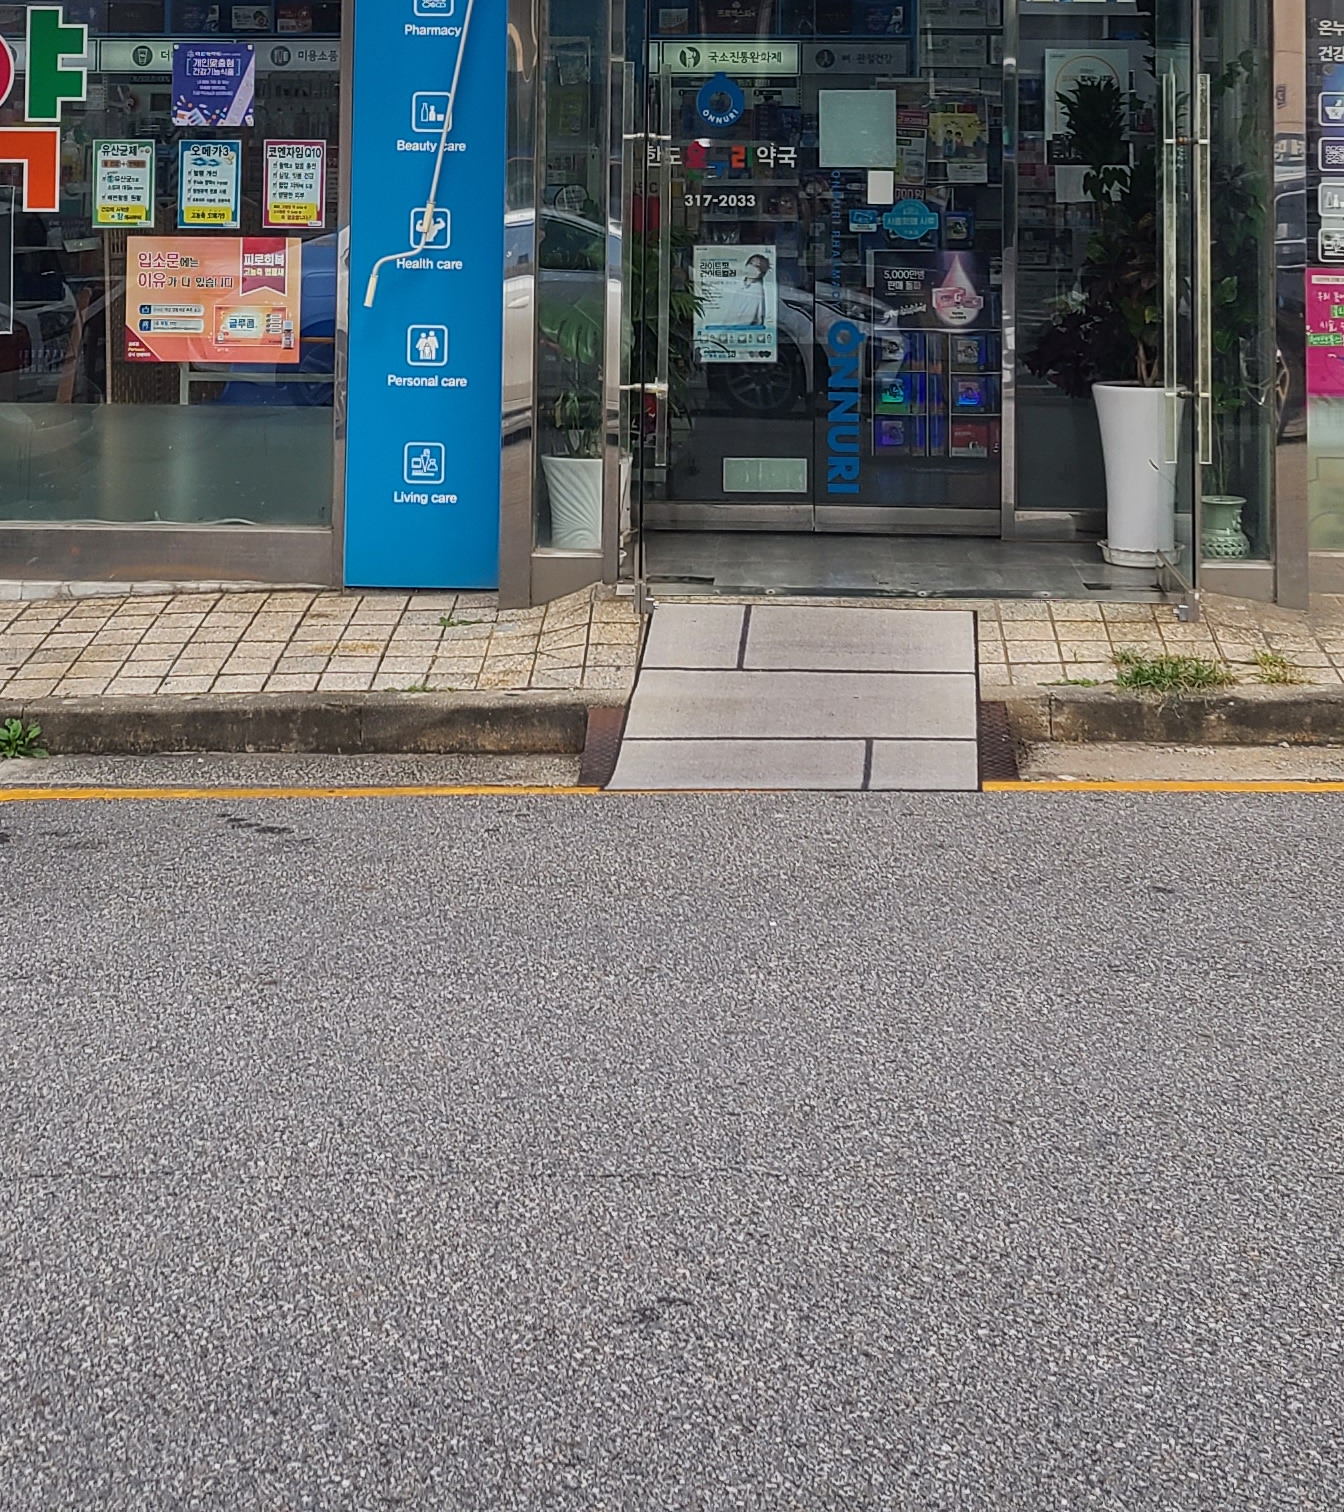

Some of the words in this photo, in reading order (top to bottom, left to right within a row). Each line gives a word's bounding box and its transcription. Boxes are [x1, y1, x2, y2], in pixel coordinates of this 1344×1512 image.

[405, 24, 462, 38] Pharmacy
[298, 50, 339, 62] 미용소품
[707, 50, 782, 64] 국소진통완화제
[703, 108, 739, 124] ONNURI
[102, 144, 137, 157] 유산균제
[191, 145, 229, 157] 오메가3
[268, 146, 322, 159] 코엔자임Q10
[397, 140, 437, 153] Beauty
[684, 194, 756, 208] 317-2033
[138, 252, 199, 269] 입소문에는
[244, 253, 285, 266] 피로회복
[396, 258, 433, 270] Health
[437, 261, 463, 270] care
[138, 272, 178, 289] 이유가
[181, 277, 191, 288] 다
[195, 277, 233, 288] 있습니다
[388, 374, 438, 387] Personal
[441, 377, 467, 387] care
[827, 320, 865, 494] ONNURI
[394, 491, 427, 505] Living
[431, 494, 457, 504] care
